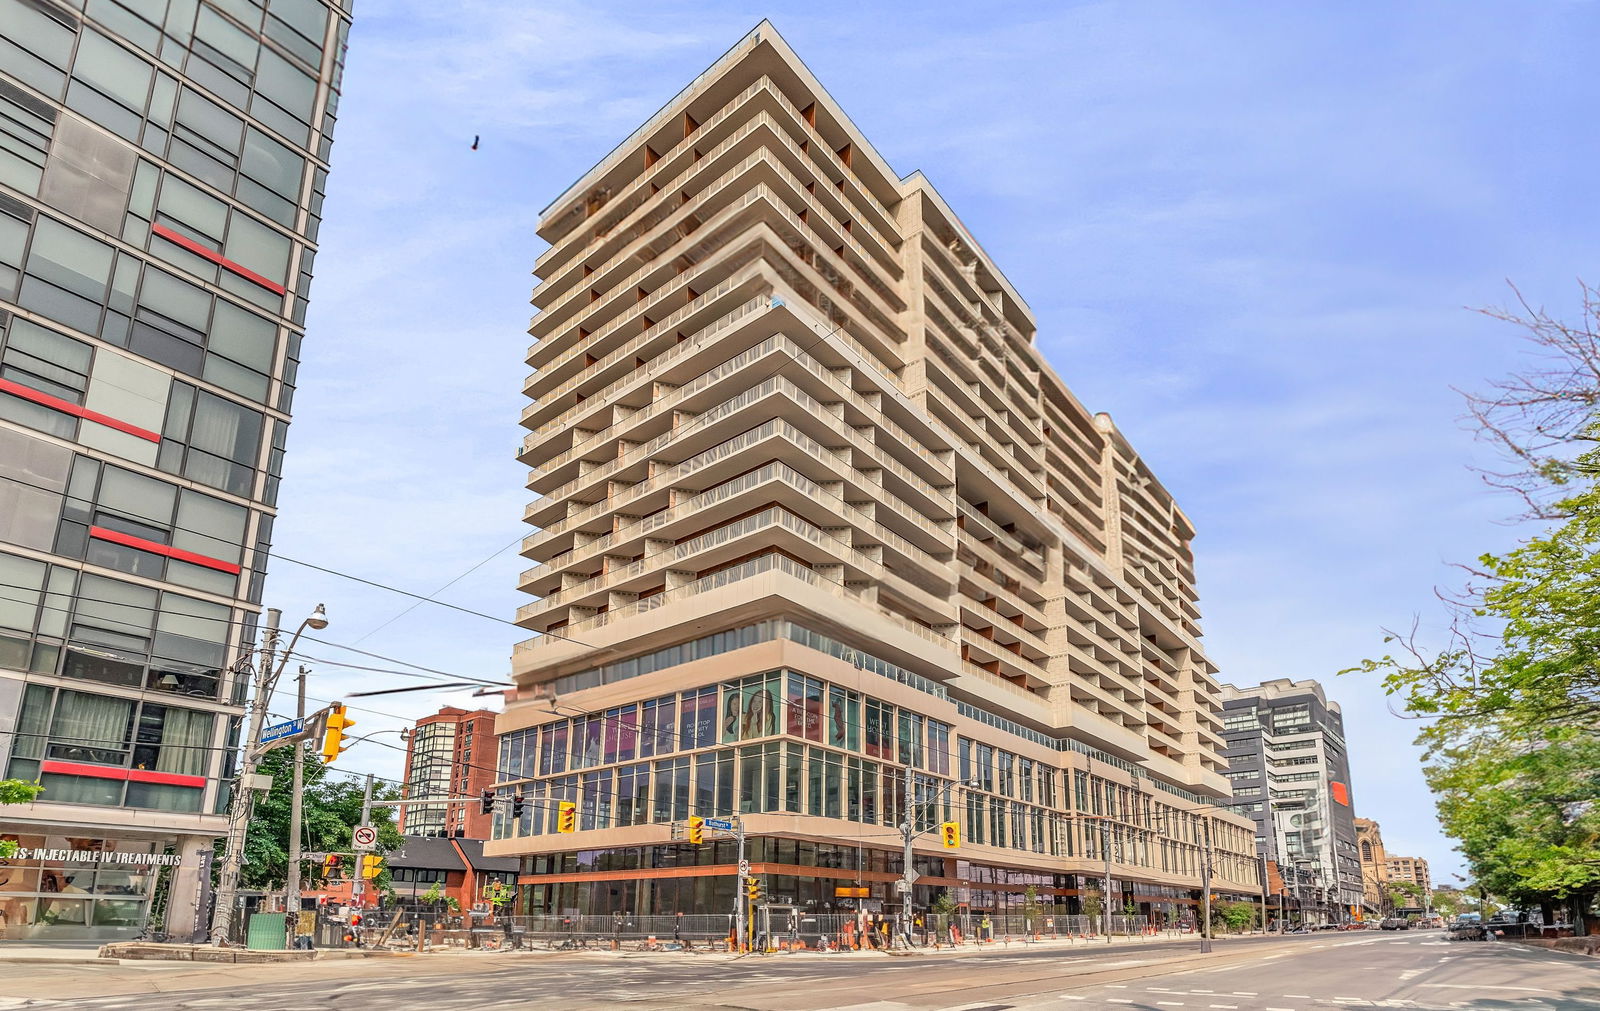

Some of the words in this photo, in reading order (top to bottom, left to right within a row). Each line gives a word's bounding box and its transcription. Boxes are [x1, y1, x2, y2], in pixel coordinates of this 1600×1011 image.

[869, 717, 888, 729] WET
[262, 724, 292, 739] Wellington
[33, 848, 99, 863] INJECTABLE
[100, 851, 116, 863] IV
[116, 852, 182, 866] TREATMENTS
